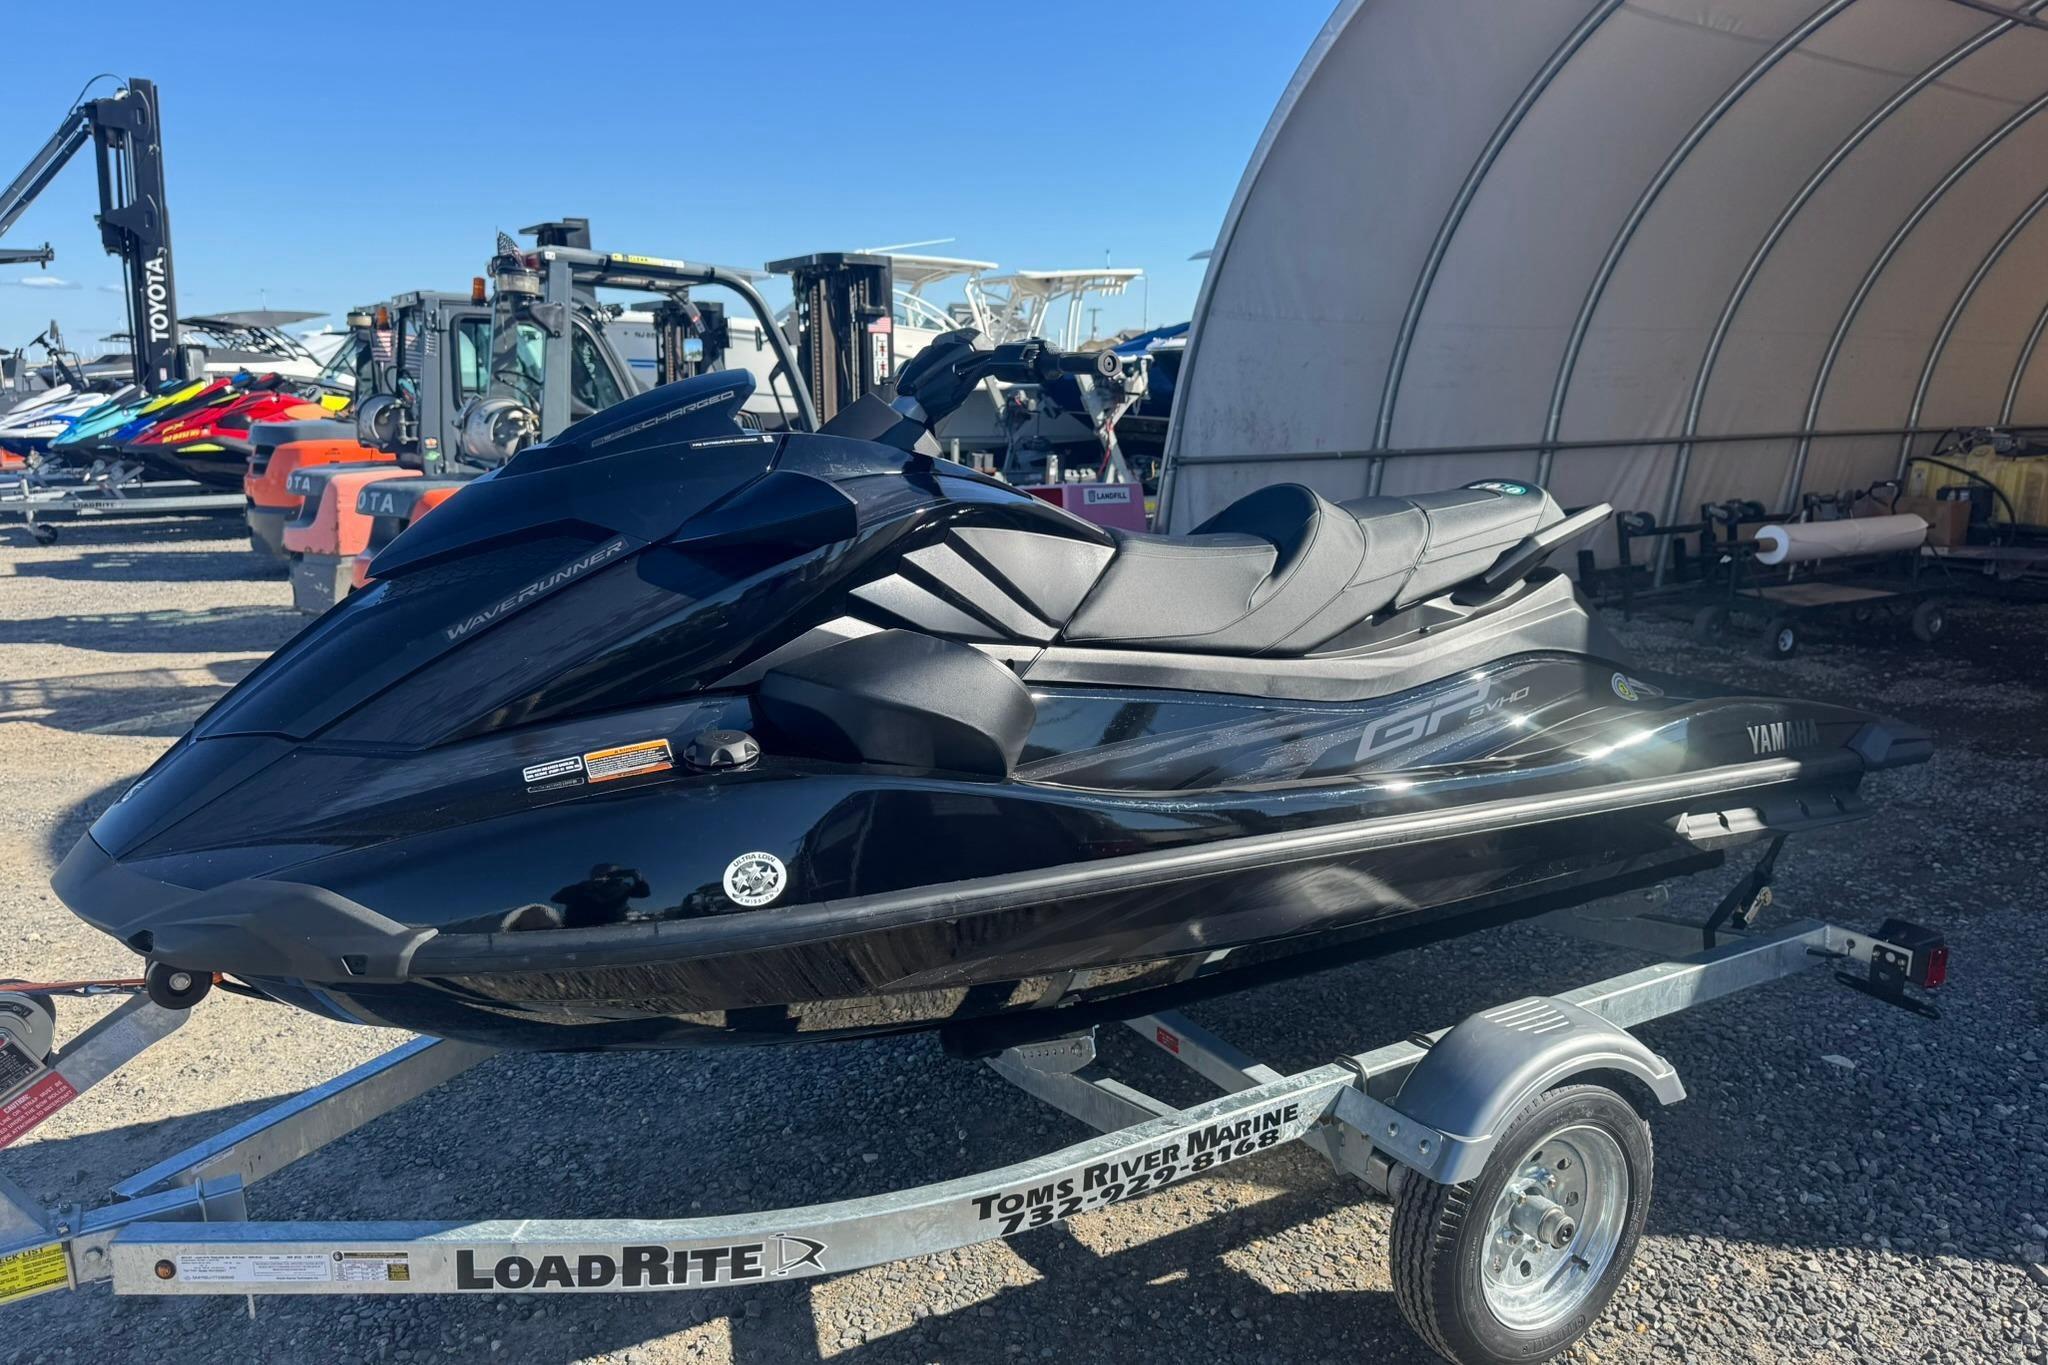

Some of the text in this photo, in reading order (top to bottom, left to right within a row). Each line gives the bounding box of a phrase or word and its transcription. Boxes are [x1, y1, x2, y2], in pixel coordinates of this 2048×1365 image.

[145, 257, 169, 343] TOYOTA
[1096, 491, 1127, 500] LANDFILL
[447, 541, 622, 640] WAVERUNNER
[1354, 679, 1491, 762] GP
[1468, 686, 1530, 720] SVHO
[1747, 719, 1819, 754] YAMAHA
[733, 853, 776, 867] ULTRA LOW
[9, 1115, 25, 1129] UNDER
[25, 1107, 35, 1116] THE
[36, 1099, 48, 1110] BOW
[22, 1097, 38, 1111] STRAP
[40, 1086, 54, 1098] MUST
[972, 1103, 1299, 1221] TOMS RIVER MARINE
[998, 1128, 1280, 1238] 732-929-8168
